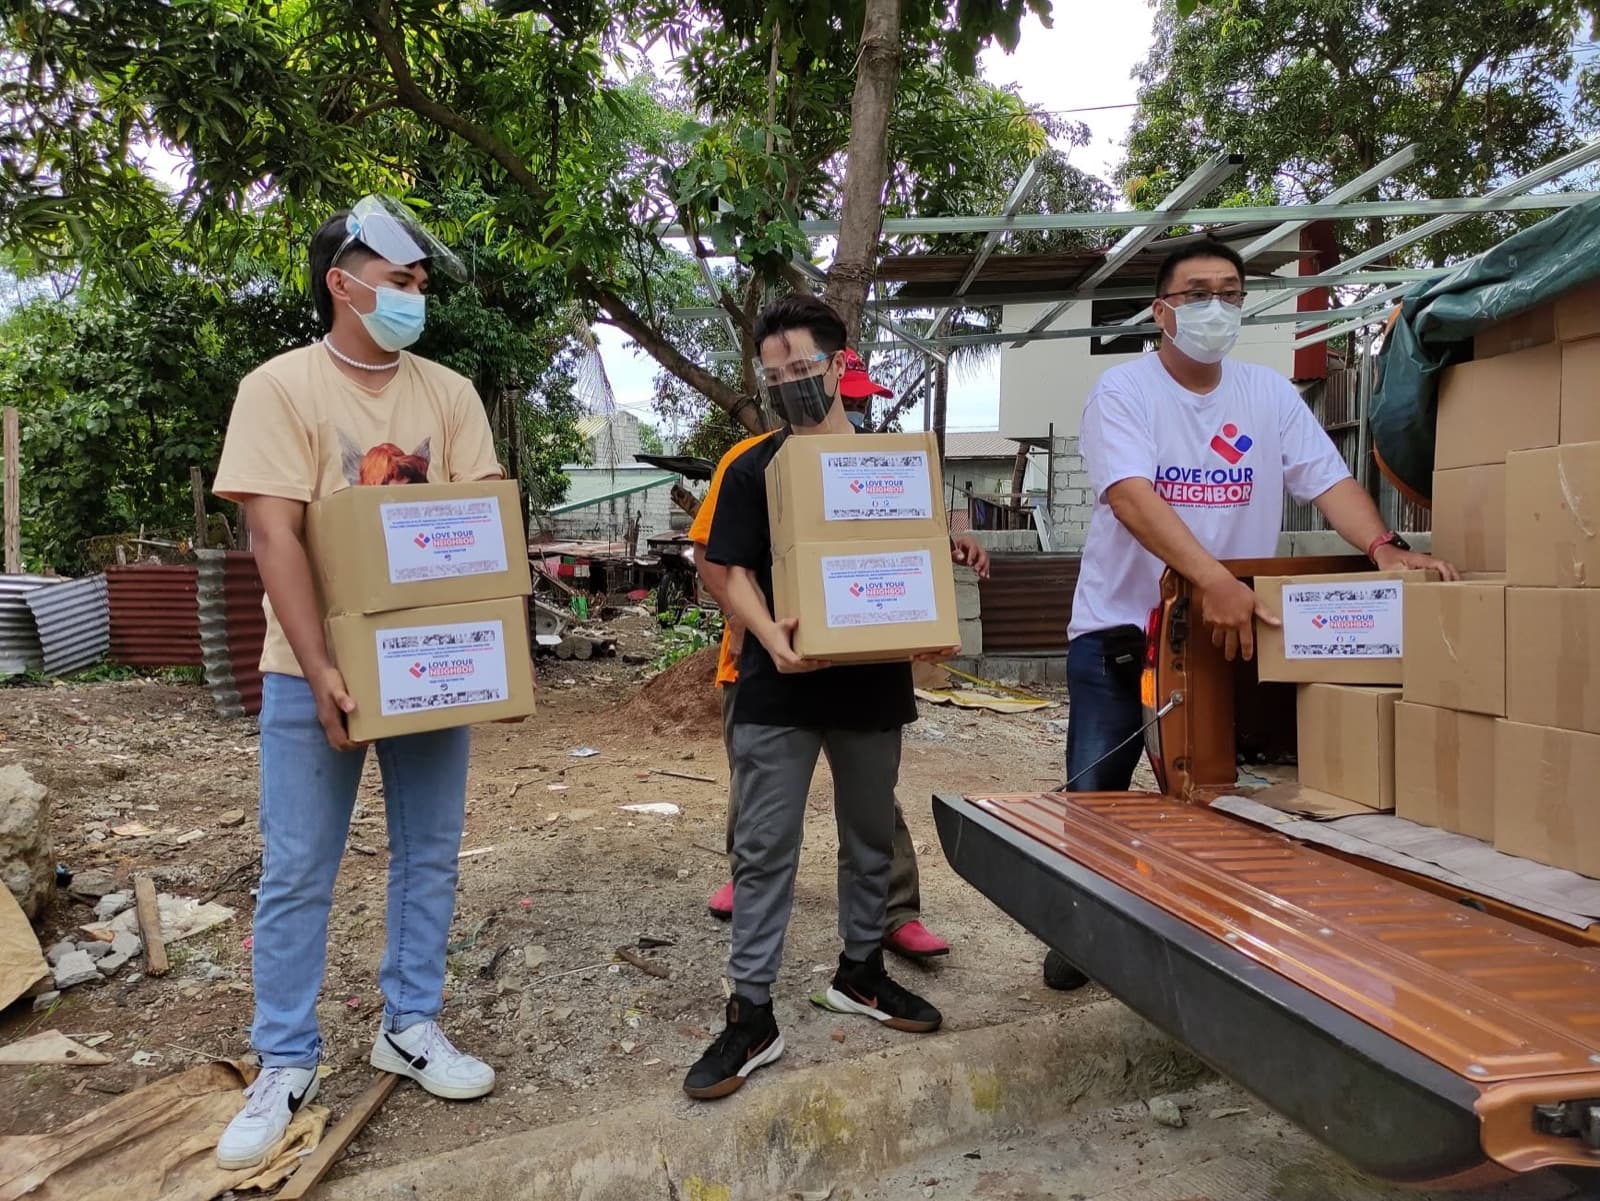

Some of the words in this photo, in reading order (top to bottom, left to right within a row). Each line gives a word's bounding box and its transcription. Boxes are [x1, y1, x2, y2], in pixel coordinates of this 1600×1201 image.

[1155, 465, 1202, 483] LOVE
[432, 531, 451, 539] LOVE
[433, 536, 475, 547] NEIGHBOR
[428, 660, 448, 668] LOVE
[450, 658, 473, 666] YOUR
[429, 665, 474, 677] NEIGHBOR
